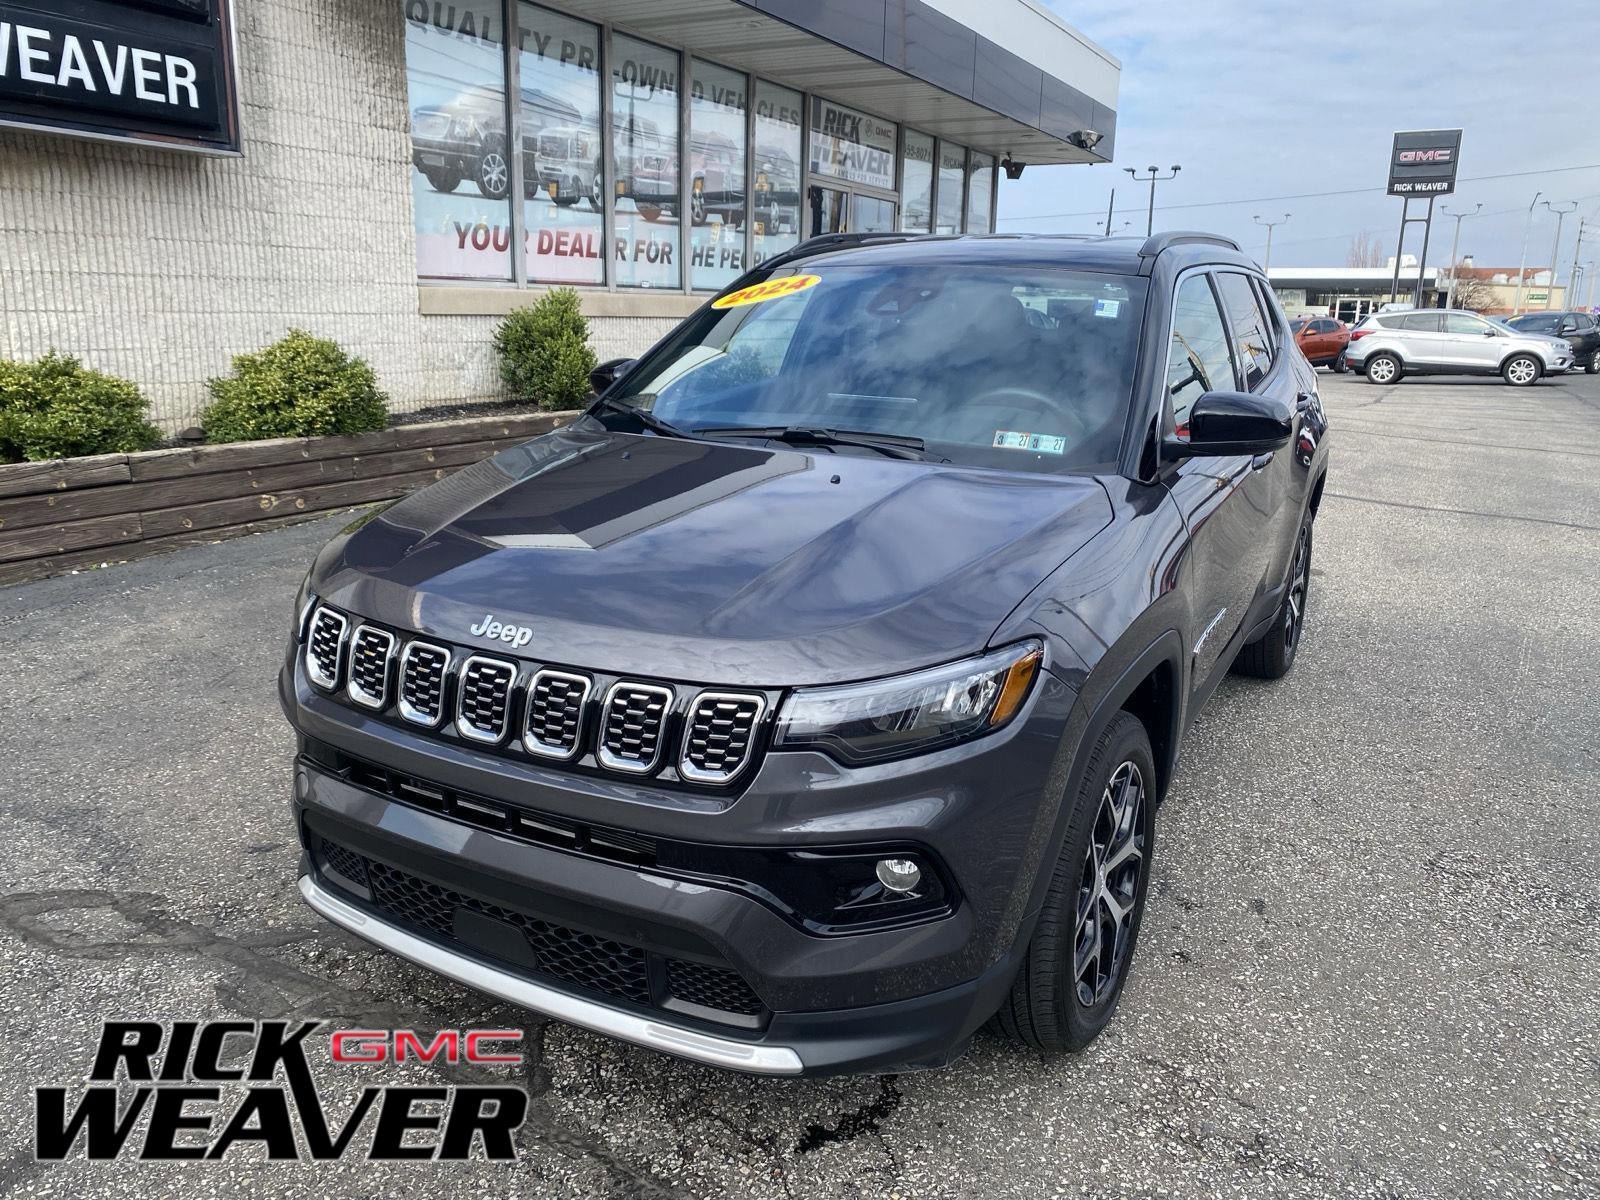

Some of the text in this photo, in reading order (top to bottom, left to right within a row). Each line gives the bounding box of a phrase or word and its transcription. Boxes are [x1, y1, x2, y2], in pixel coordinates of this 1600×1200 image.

[0, 22, 200, 109] EAVER
[405, 0, 552, 61] QUALTY
[560, 39, 704, 104] PR-OWND
[823, 107, 862, 143] RICK
[1400, 149, 1451, 162] GMC
[1393, 182, 1448, 192] RICK WEAVER
[453, 221, 529, 254] YOU
[537, 229, 627, 262] DEALR
[633, 239, 673, 265] FOR
[691, 245, 716, 268] HE
[720, 277, 811, 305] 2024
[470, 614, 533, 649] Jeep
